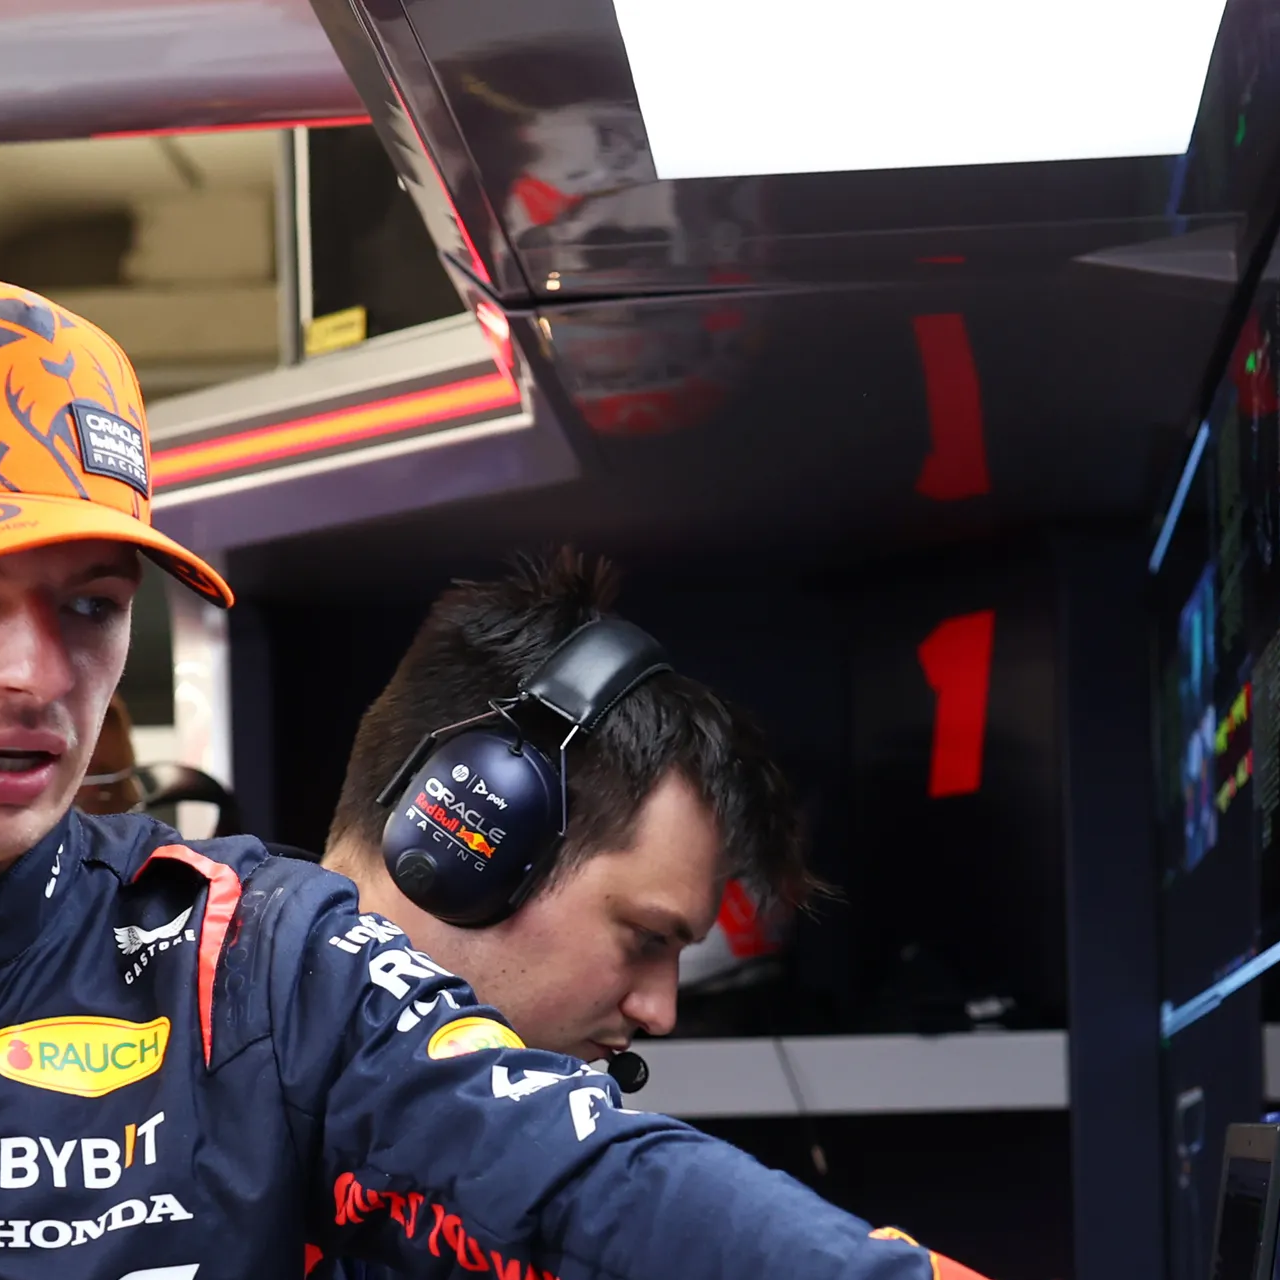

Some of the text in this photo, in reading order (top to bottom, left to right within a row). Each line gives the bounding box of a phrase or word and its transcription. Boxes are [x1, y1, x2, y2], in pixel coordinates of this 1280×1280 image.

[86, 414, 142, 450] ORACLE
[918, 609, 995, 798] 1
[425, 778, 507, 844] ORACLE
[486, 793, 508, 811] poly
[406, 807, 486, 872] RACING
[39, 1031, 160, 1073] RAUCH
[0, 1111, 165, 1189] BYBIT
